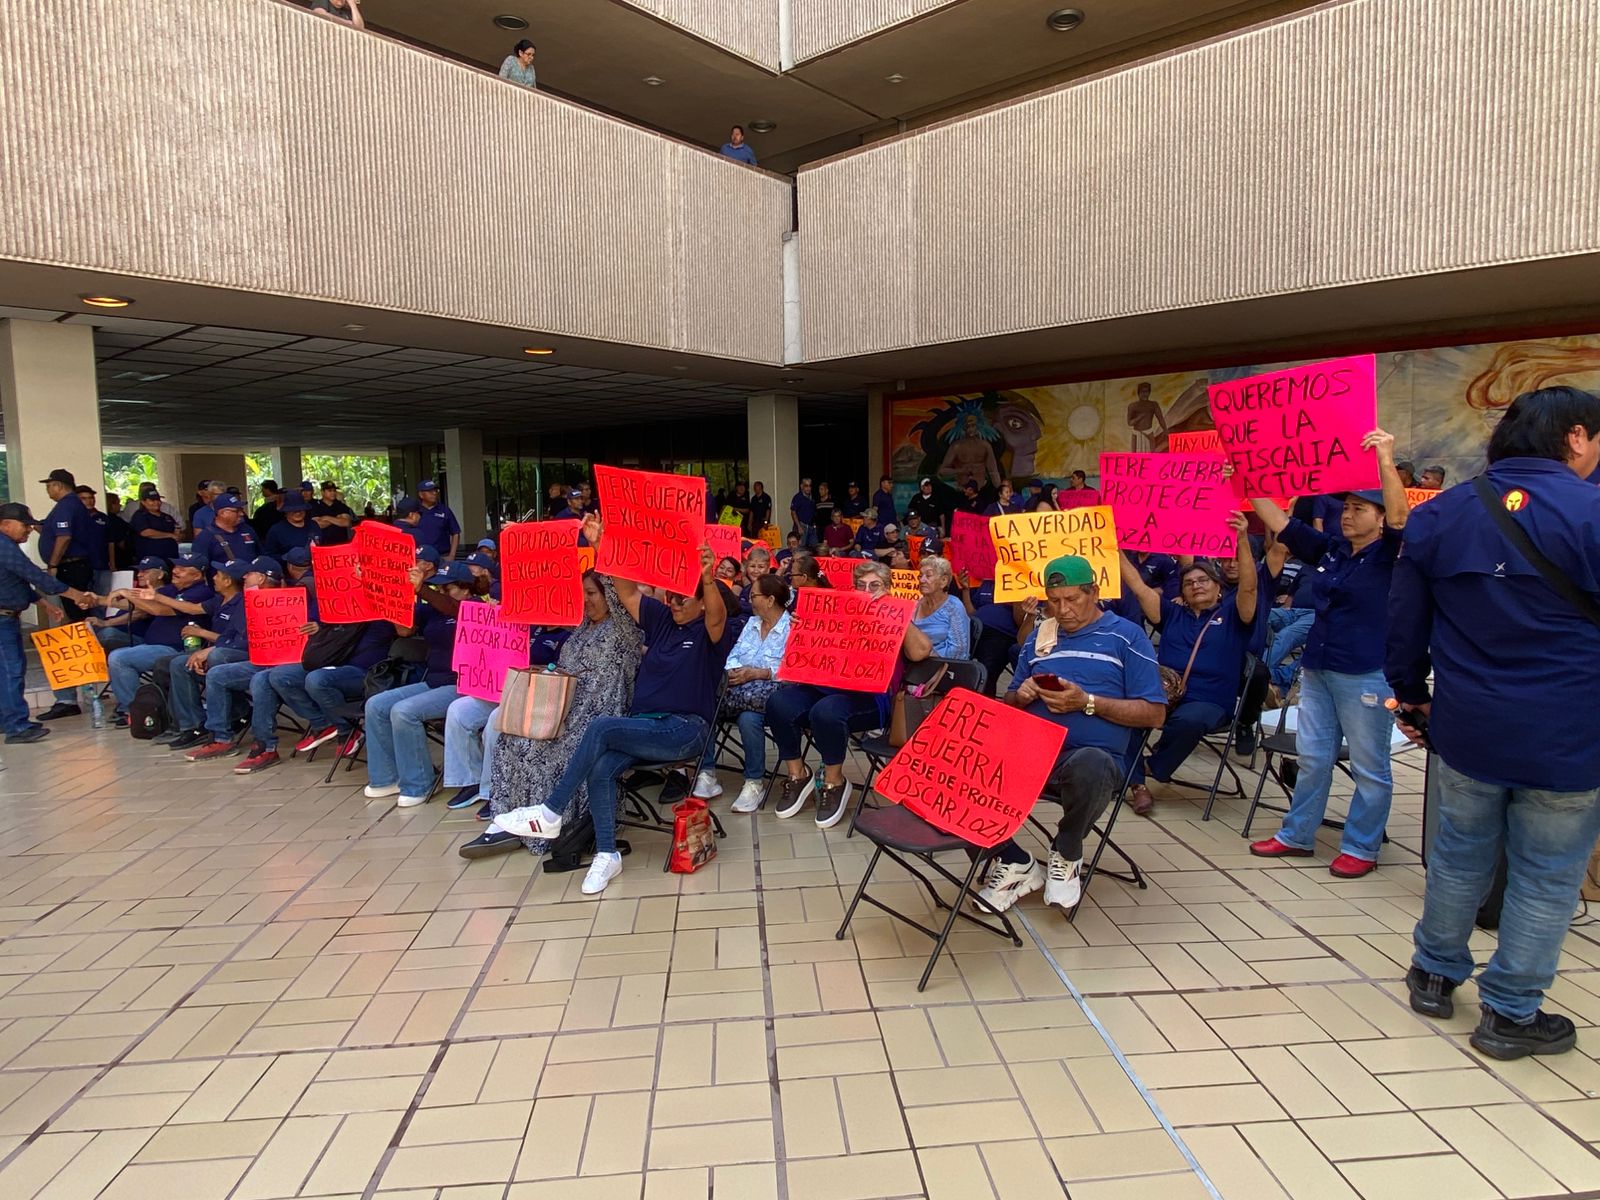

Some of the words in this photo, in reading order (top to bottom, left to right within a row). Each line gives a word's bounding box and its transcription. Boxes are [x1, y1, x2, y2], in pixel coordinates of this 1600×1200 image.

[1214, 369, 1353, 414] QUEREMOS
[1219, 420, 1258, 445] QUE
[1282, 409, 1317, 439] LA
[1174, 438, 1198, 452] HAY
[1230, 437, 1350, 474] FISCALIA
[1103, 456, 1152, 480] TERE
[600, 474, 640, 506] TERE
[644, 480, 703, 516] GUERRA
[1103, 480, 1215, 510] PROTEGE
[1244, 469, 1323, 498] ACTUE
[606, 505, 690, 544] EXIGIMOS
[994, 520, 1020, 539] LA
[1029, 512, 1106, 535] VERDAD
[1144, 512, 1158, 529] A
[508, 527, 578, 556] DIPUTADOS
[999, 539, 1048, 565] DEBE
[1061, 537, 1106, 558] SER
[1117, 527, 1152, 548] OZA
[1162, 532, 1233, 553] OCHOA
[508, 556, 573, 581] EXIGIMOS
[604, 537, 689, 586] JUSTICIA
[253, 595, 305, 608] GUERRA
[320, 596, 365, 617] TICIA
[505, 584, 574, 618] JUSTICIA
[804, 593, 840, 614] TERE
[844, 597, 905, 623] GUERRA
[893, 592, 920, 600] ANDO
[249, 627, 302, 640] RESUPUES
[266, 614, 299, 626] ESTA
[794, 618, 826, 633] DEJA
[828, 620, 844, 633] DE
[849, 619, 904, 636] PROTEGER
[35, 633, 59, 648] LA
[47, 640, 95, 664] DEBE
[458, 626, 468, 644] A
[471, 628, 500, 649] OSCAR
[503, 633, 528, 655] LOZA
[791, 633, 805, 646] AL
[810, 636, 896, 653] VIOLENTADOR
[479, 648, 486, 670] A
[785, 652, 836, 674] OSCAR
[840, 656, 885, 680] LOZA
[912, 726, 1004, 795] GUERRA
[897, 753, 933, 781] DEJE
[937, 772, 957, 790] DE
[958, 782, 1023, 822] PROTEGER
[877, 769, 892, 791] A
[894, 774, 957, 823] OSCAR
[956, 808, 1010, 843] LOZA
